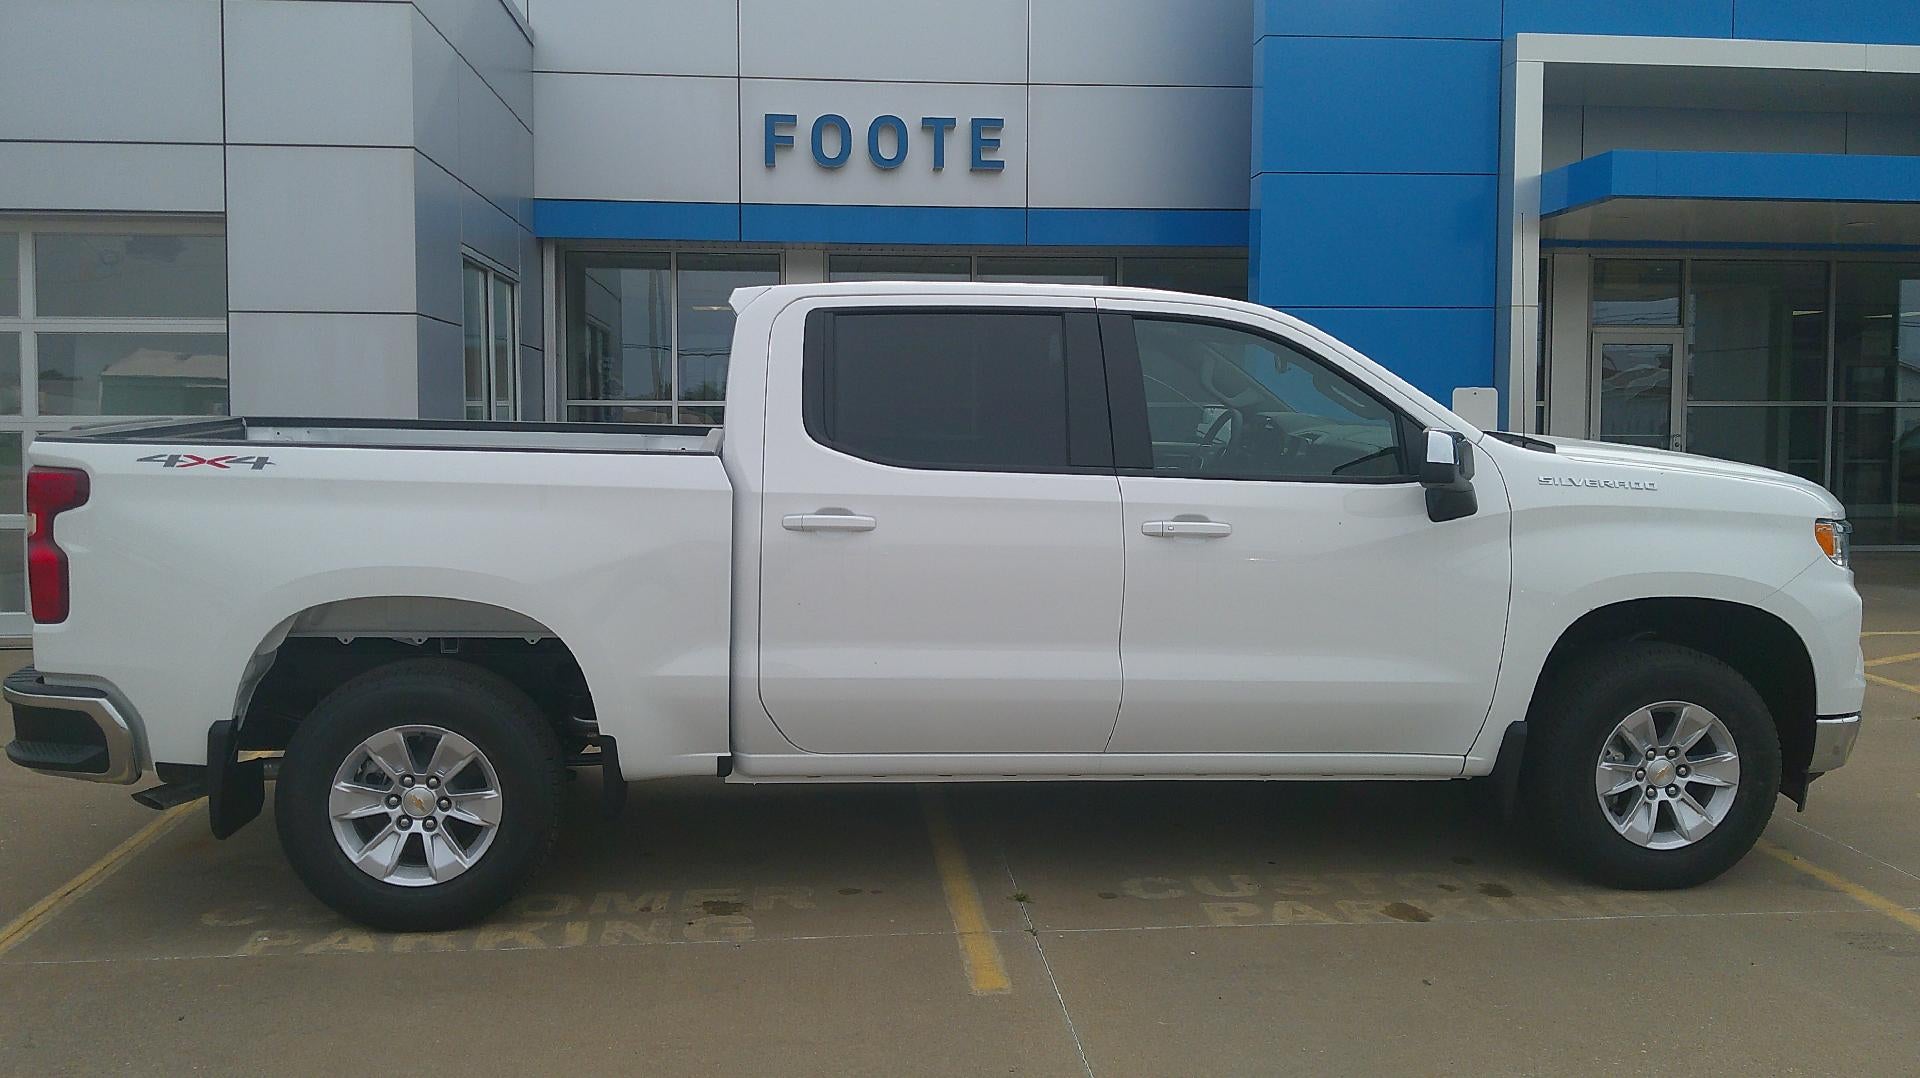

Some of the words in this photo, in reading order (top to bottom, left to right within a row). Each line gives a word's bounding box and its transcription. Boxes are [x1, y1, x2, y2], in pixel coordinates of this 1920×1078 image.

[764, 113, 1005, 171] FOOTE
[1538, 475, 1658, 491] SILVERADO
[200, 887, 817, 926] COMER
[232, 915, 756, 955] PARKING
